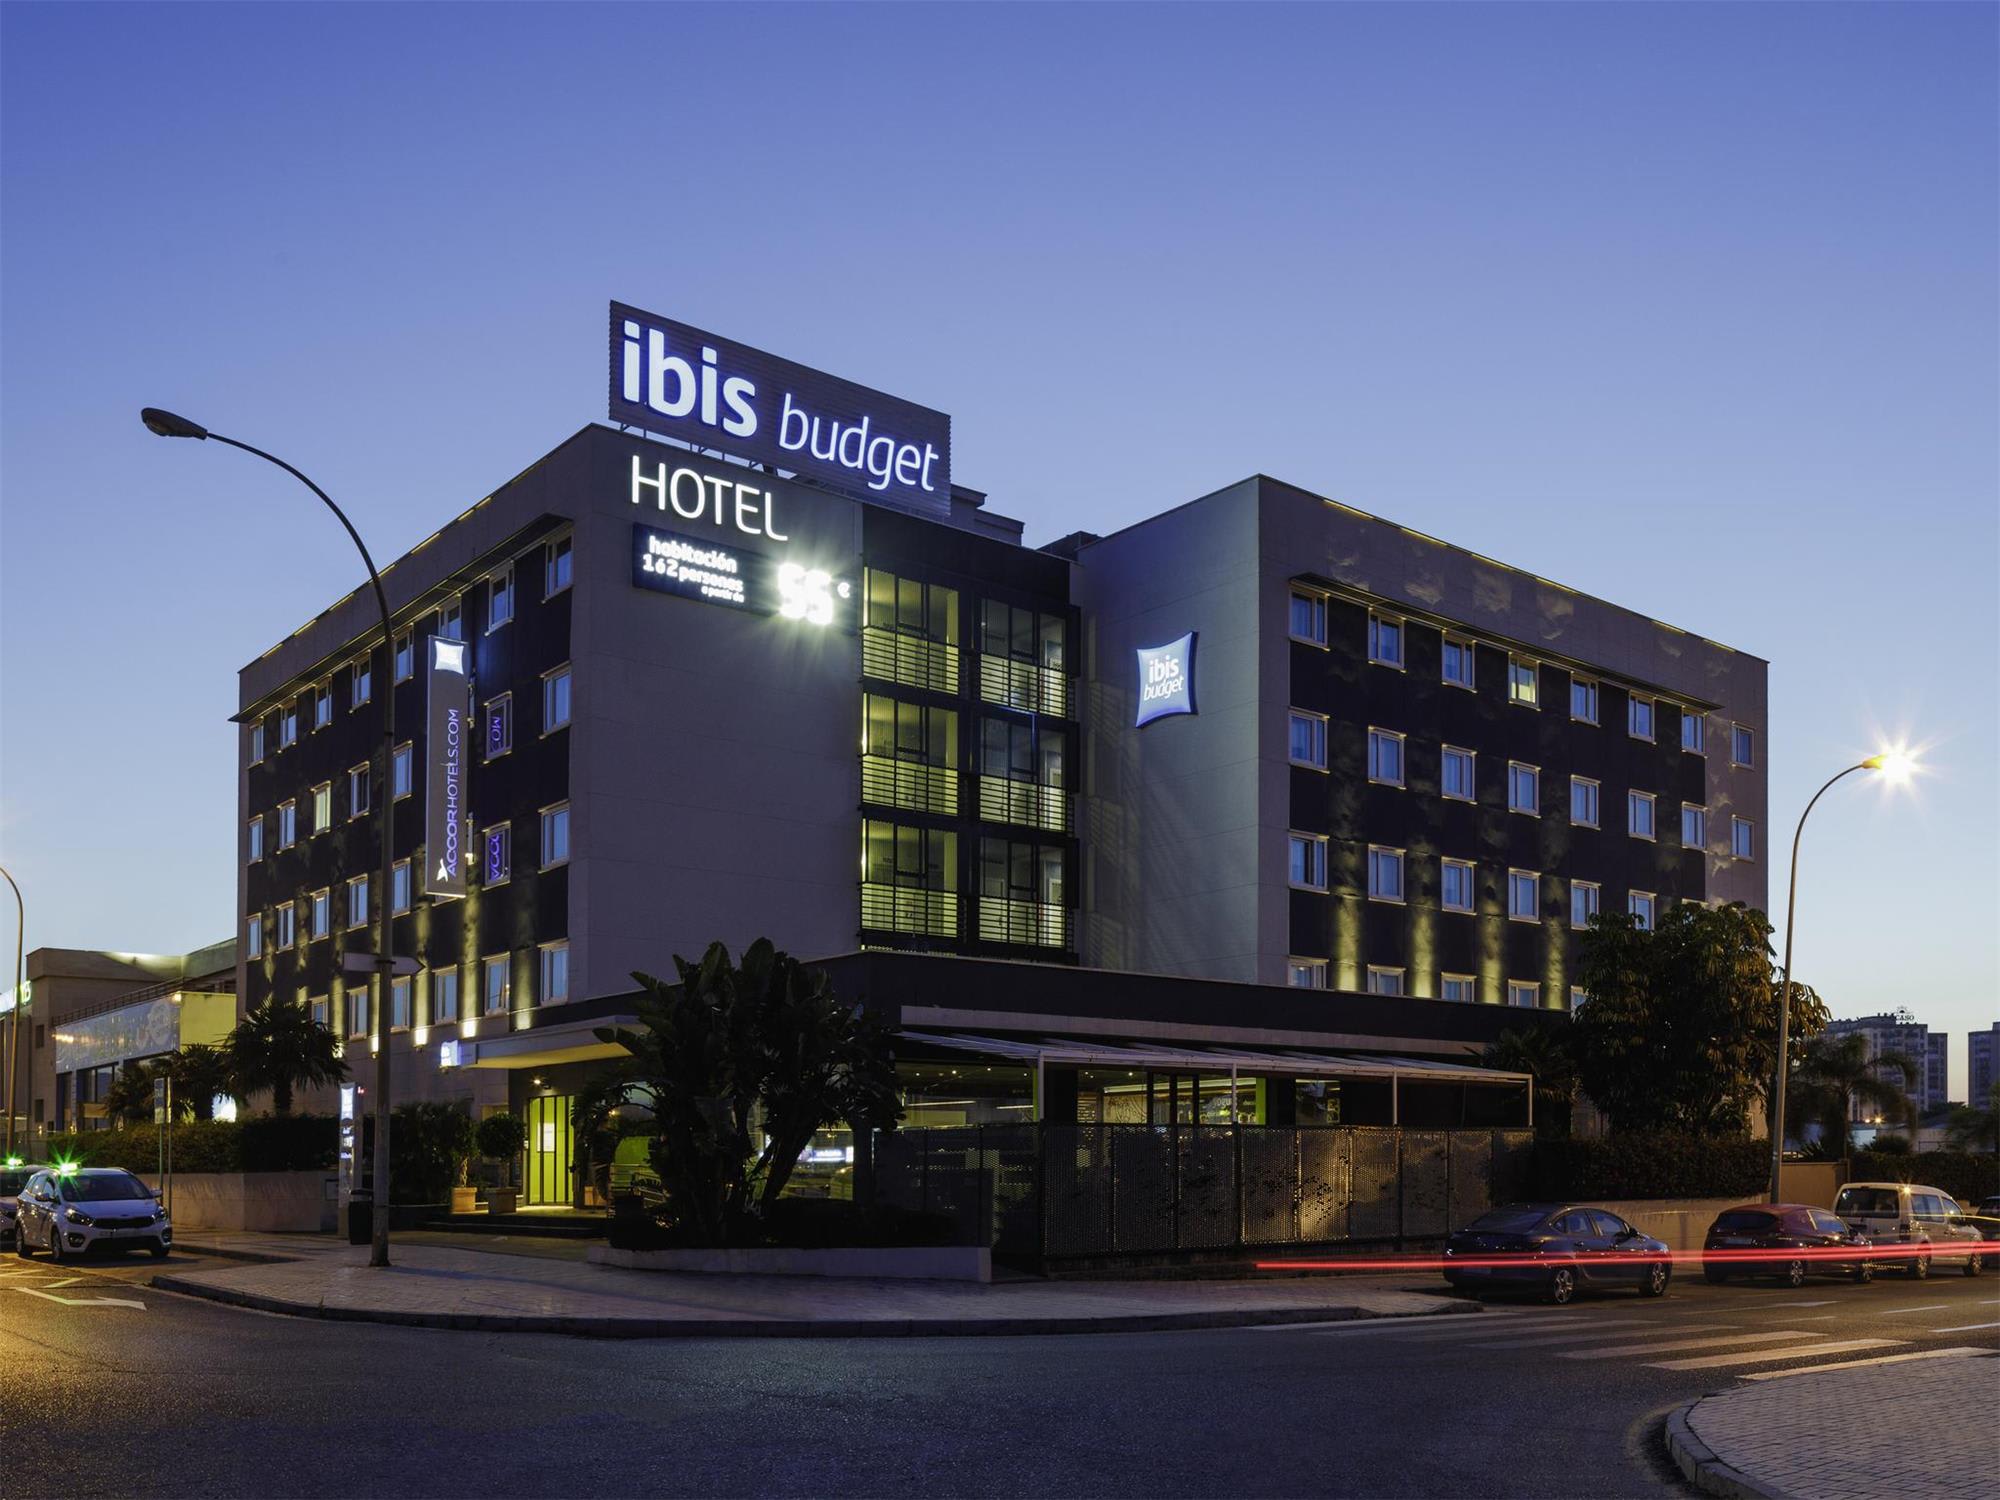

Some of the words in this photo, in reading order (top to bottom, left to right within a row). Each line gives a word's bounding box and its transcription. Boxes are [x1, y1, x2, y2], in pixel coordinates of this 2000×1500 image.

[624, 319, 758, 437] ibis
[779, 392, 939, 491] budget
[631, 454, 788, 541] HOTEL
[643, 553, 655, 572] 1
[666, 558, 679, 577] 2
[649, 535, 737, 573] habitación
[1144, 675, 1184, 700] budget
[1149, 655, 1180, 683] ibis
[447, 709, 459, 877] ACCORHOTELS.COM
